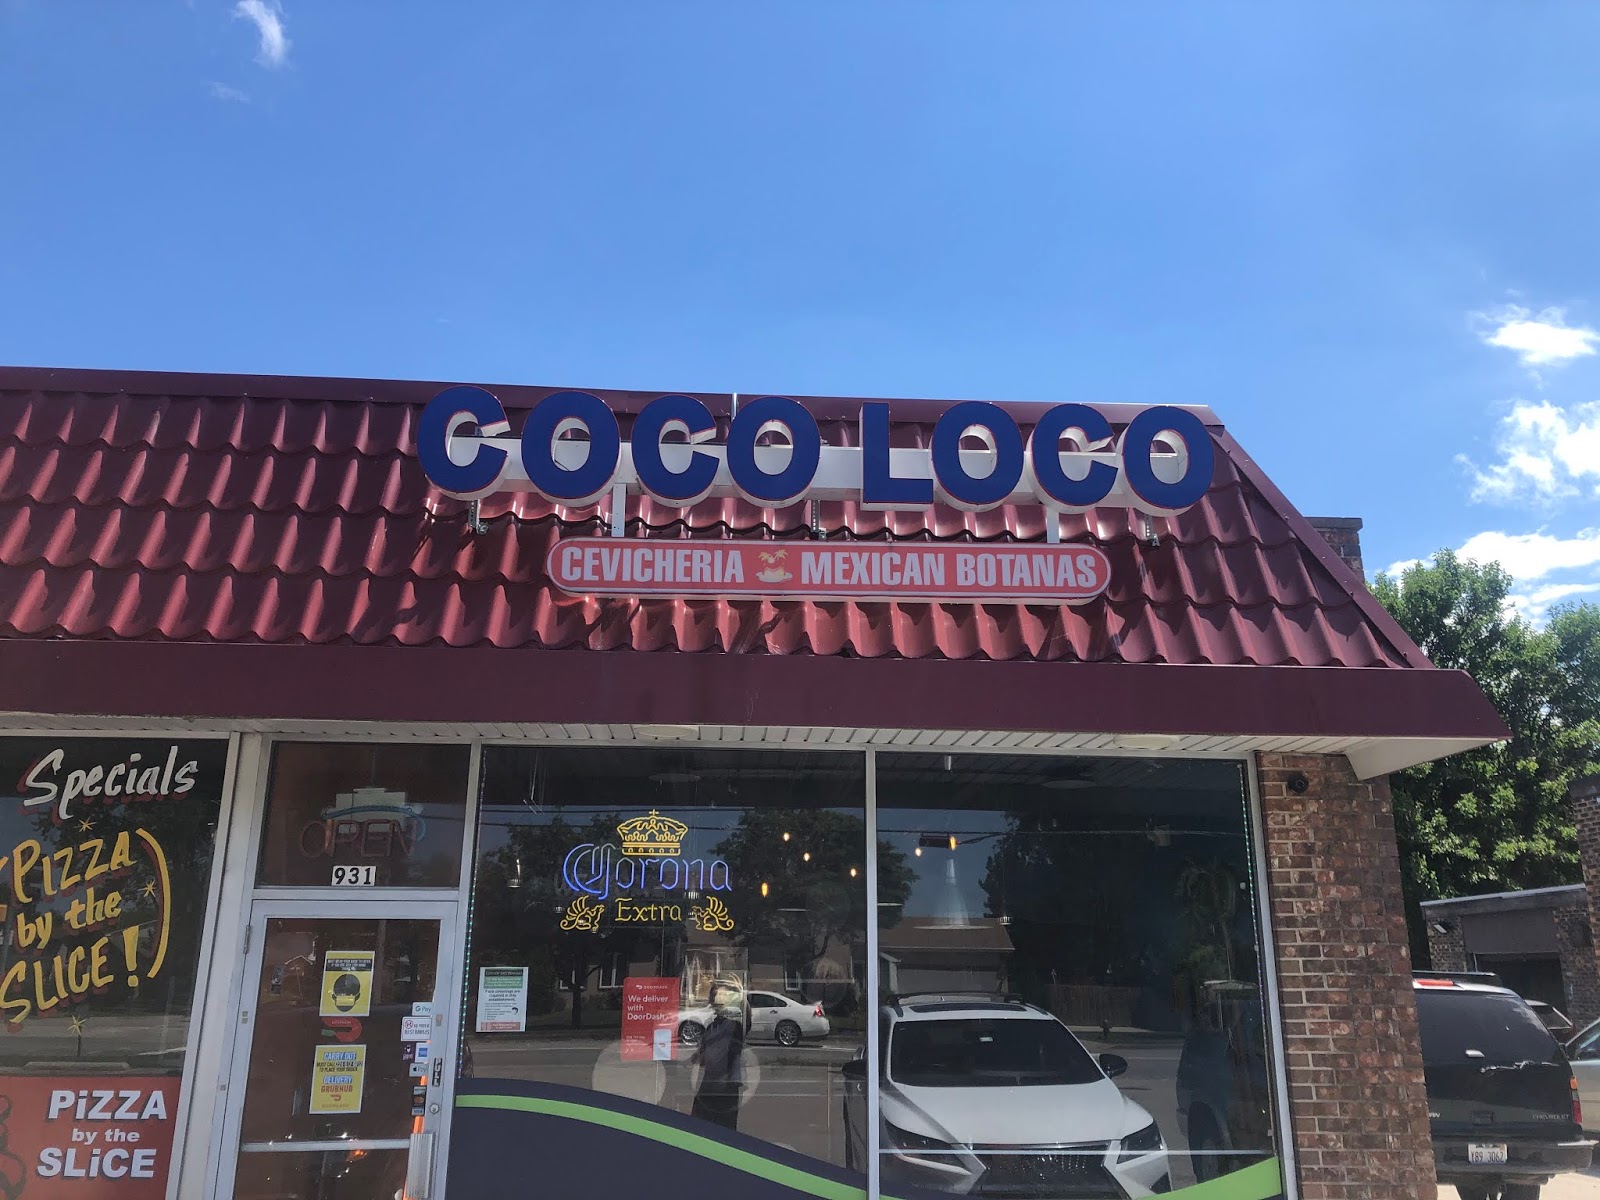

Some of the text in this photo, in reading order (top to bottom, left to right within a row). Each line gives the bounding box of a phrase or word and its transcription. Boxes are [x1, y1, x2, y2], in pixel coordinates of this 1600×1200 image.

[416, 385, 1216, 515] COCO LOCO
[560, 546, 1098, 589] CEVICHERIA MEXICAN BOTANAS
[23, 745, 198, 820] Specials
[300, 818, 418, 858] OPEN
[13, 831, 138, 904] PIZZA
[334, 867, 372, 885] 931
[563, 843, 733, 900] Corona
[17, 888, 122, 949] by the
[614, 898, 683, 922] Extra
[627, 1004, 644, 1012] with
[628, 995, 669, 1003] We deliver
[433, 1058, 442, 1086] PULL
[71, 1128, 140, 1145] by the
